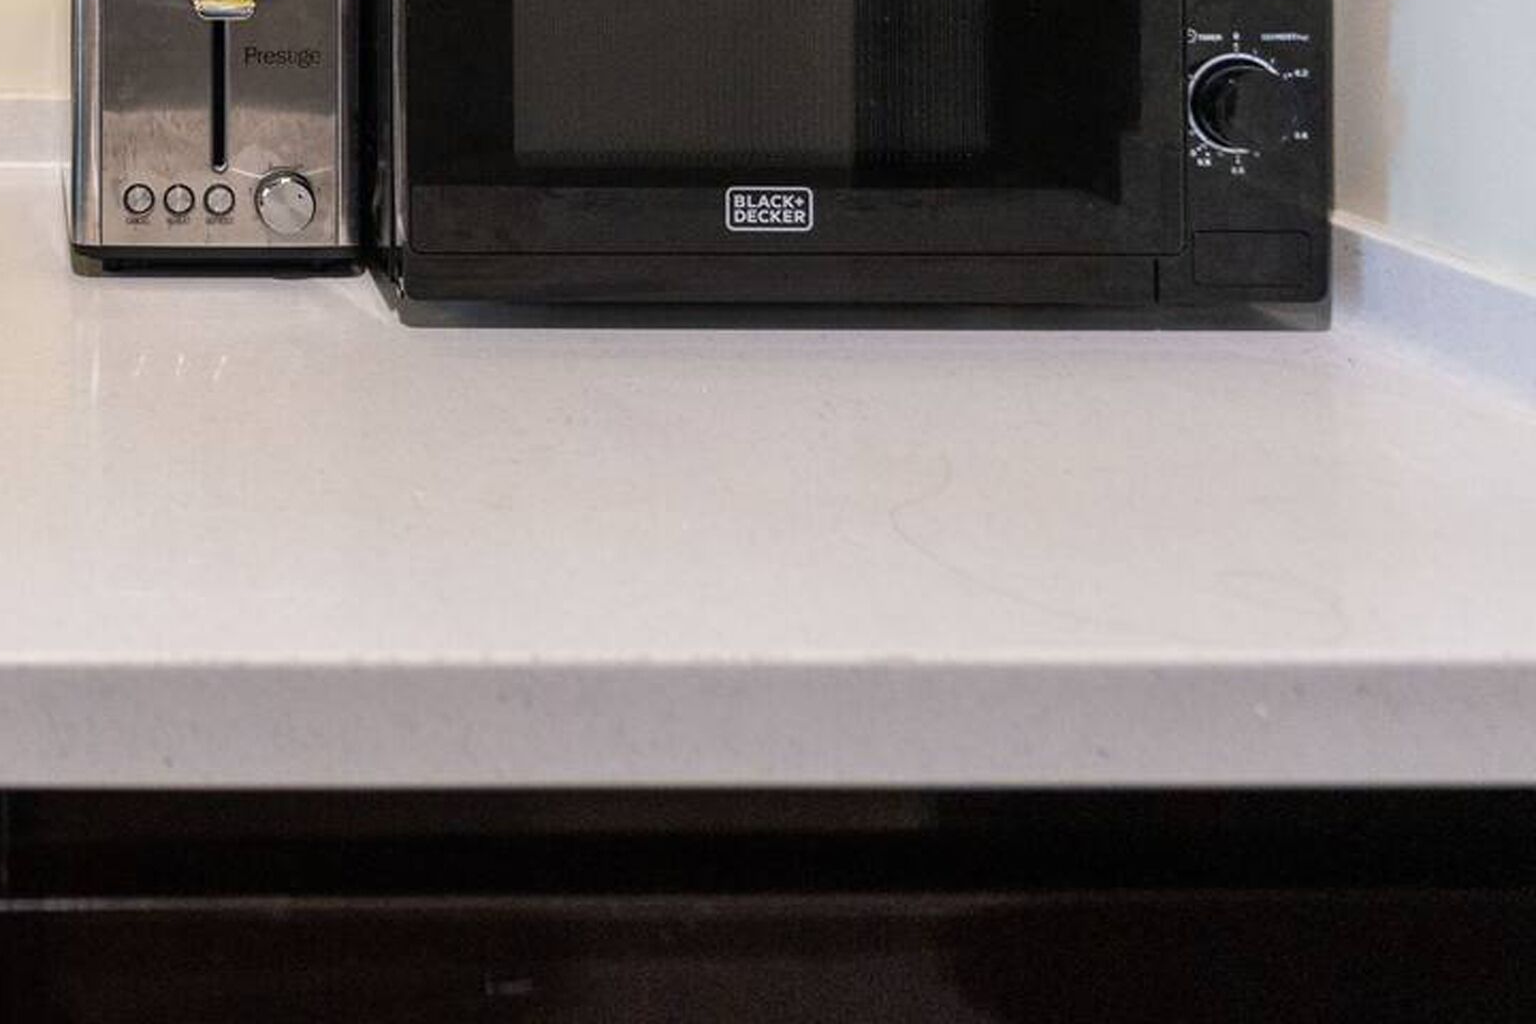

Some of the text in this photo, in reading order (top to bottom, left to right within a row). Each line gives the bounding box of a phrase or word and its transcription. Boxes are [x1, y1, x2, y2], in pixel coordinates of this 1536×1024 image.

[244, 46, 321, 69] Prestige
[733, 194, 805, 208] BLACK+
[733, 209, 806, 224] DECKER
